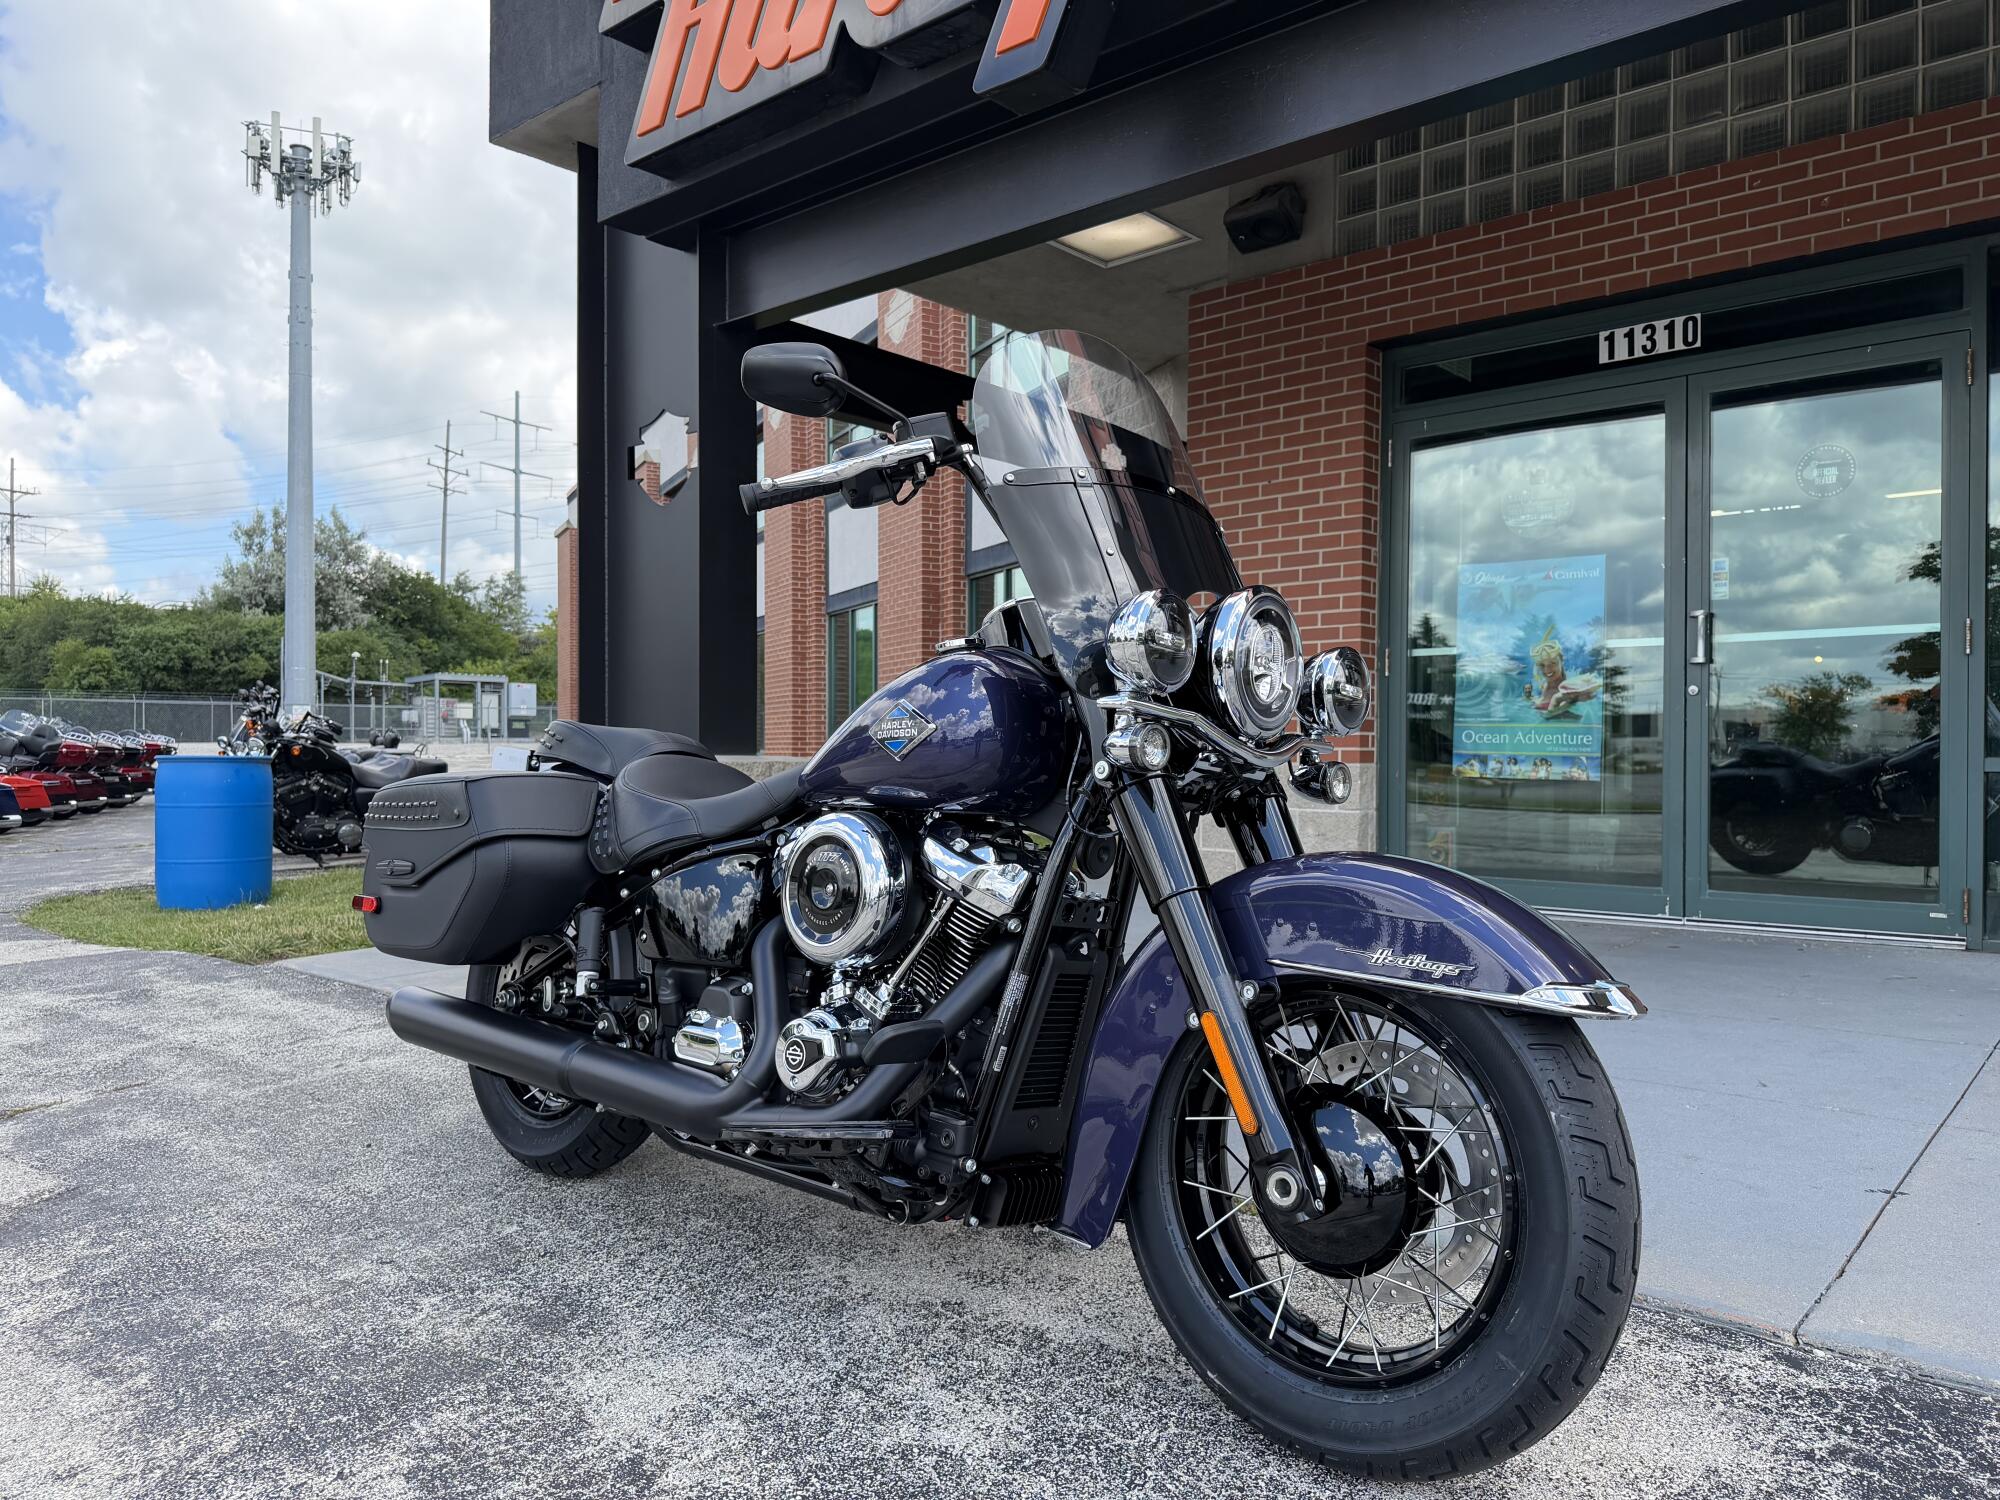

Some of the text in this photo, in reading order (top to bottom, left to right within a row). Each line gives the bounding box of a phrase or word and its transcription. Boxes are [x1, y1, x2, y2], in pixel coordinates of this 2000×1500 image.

[1603, 315, 1699, 361] 11310
[1554, 567, 1601, 580] Carnival
[877, 728, 918, 739] DAVIDSON
[1461, 729, 1593, 745] Ocean Adventure
[1336, 947, 1476, 978] Heritage
